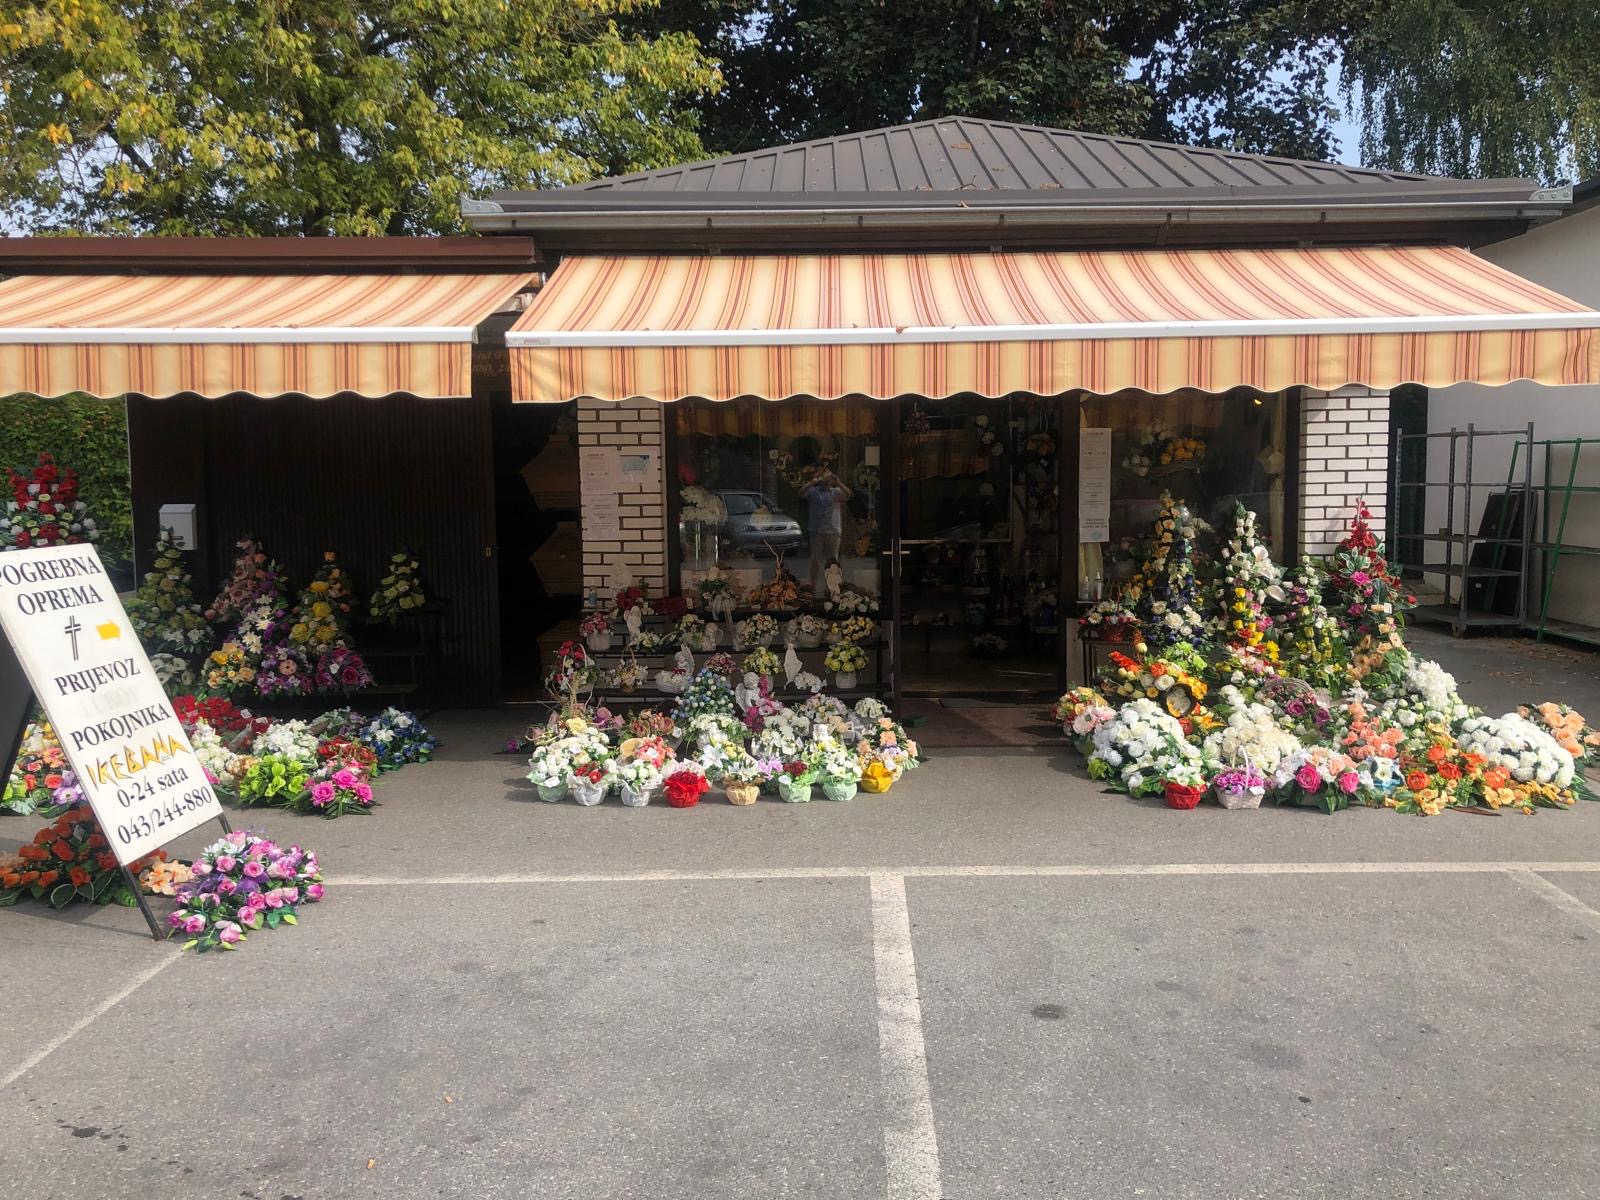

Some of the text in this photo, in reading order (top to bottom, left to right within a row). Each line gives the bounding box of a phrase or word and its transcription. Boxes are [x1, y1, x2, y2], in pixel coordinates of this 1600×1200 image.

[0, 555, 102, 587] OGREBNA
[17, 583, 104, 616] OPREMA
[54, 658, 141, 696] PRIJEVOZ
[70, 702, 172, 752] POKOJNIKA
[85, 731, 193, 792] IKEBANA
[117, 767, 189, 808] 0-24 sata
[117, 786, 212, 844] 043/244-880
